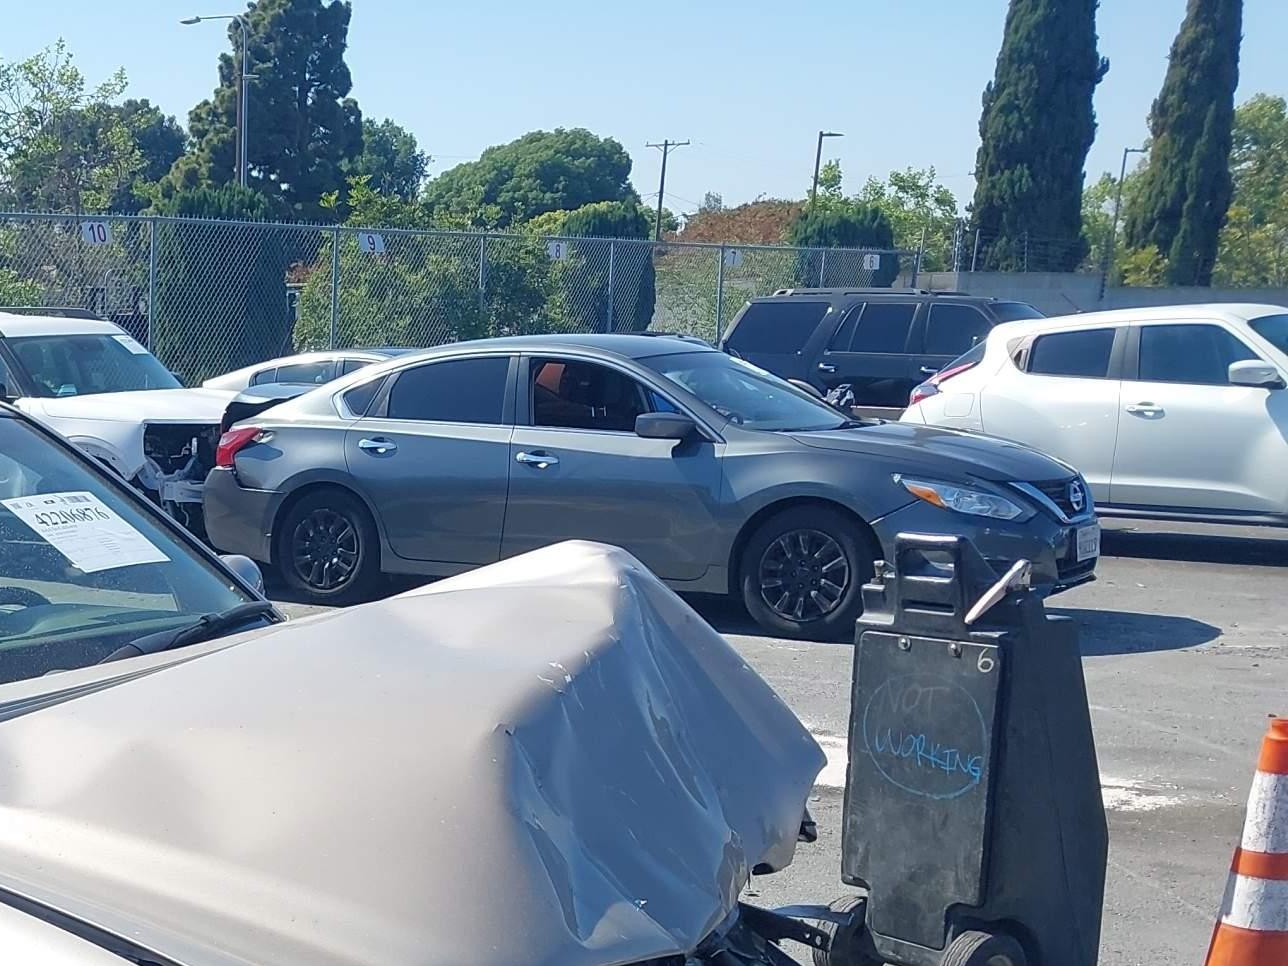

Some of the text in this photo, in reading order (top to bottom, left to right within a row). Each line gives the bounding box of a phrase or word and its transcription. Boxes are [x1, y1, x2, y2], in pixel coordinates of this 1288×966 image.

[88, 223, 107, 243] 10
[367, 235, 376, 251] 9
[555, 243, 561, 259] 8
[869, 255, 875, 269] 6
[34, 506, 111, 527] 42206876
[976, 647, 994, 673] 6
[883, 680, 950, 713] NOT
[875, 727, 983, 784] WORKING
